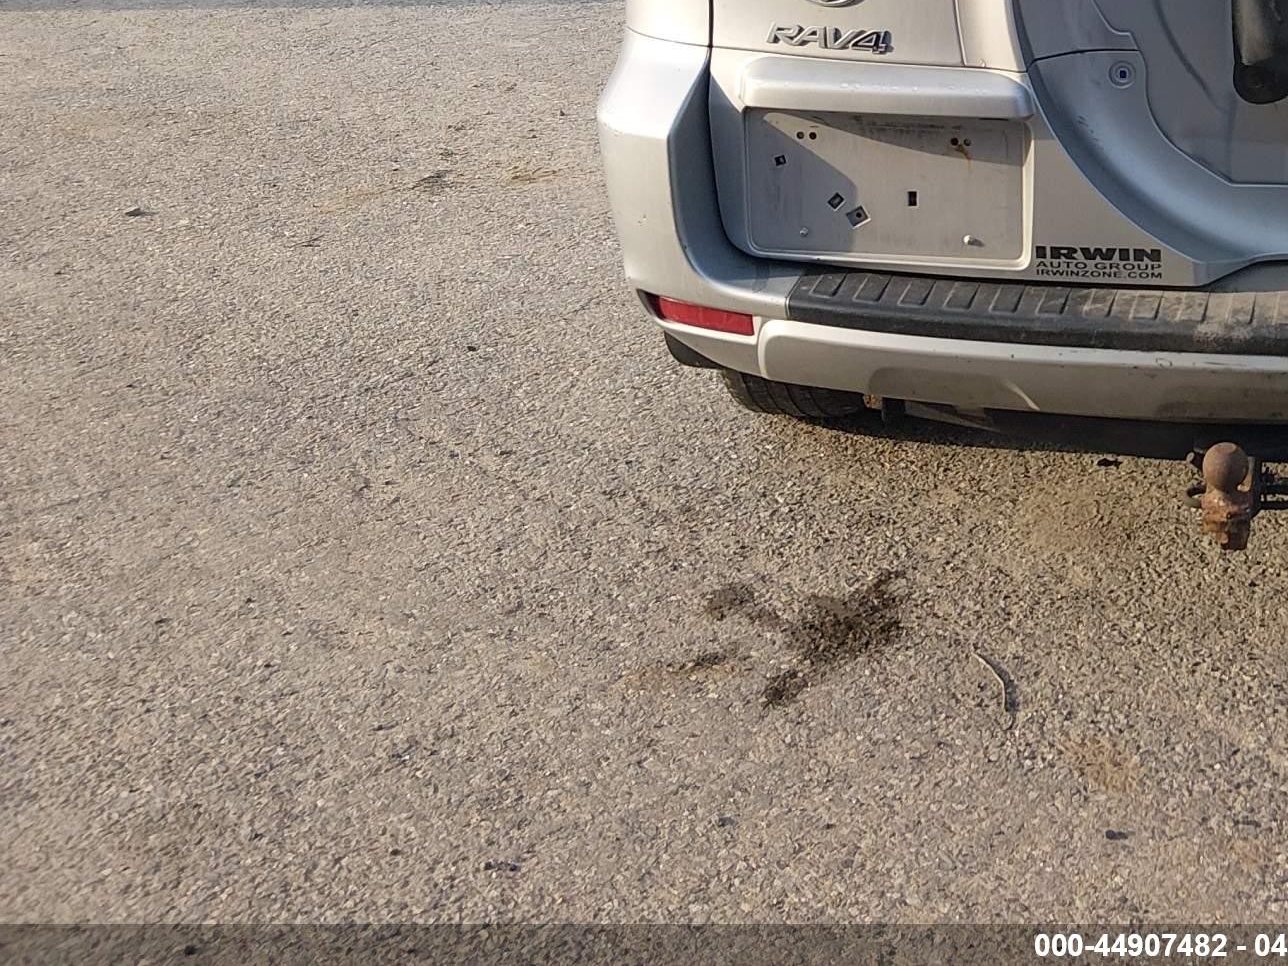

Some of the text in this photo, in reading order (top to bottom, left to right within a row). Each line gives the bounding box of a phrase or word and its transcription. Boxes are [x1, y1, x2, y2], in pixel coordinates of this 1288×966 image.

[766, 22, 890, 54] RAV4
[1035, 246, 1162, 262] IRWIN
[1036, 260, 1162, 271] AUTO GROUP
[1036, 269, 1162, 279] IRWINZONE.COM
